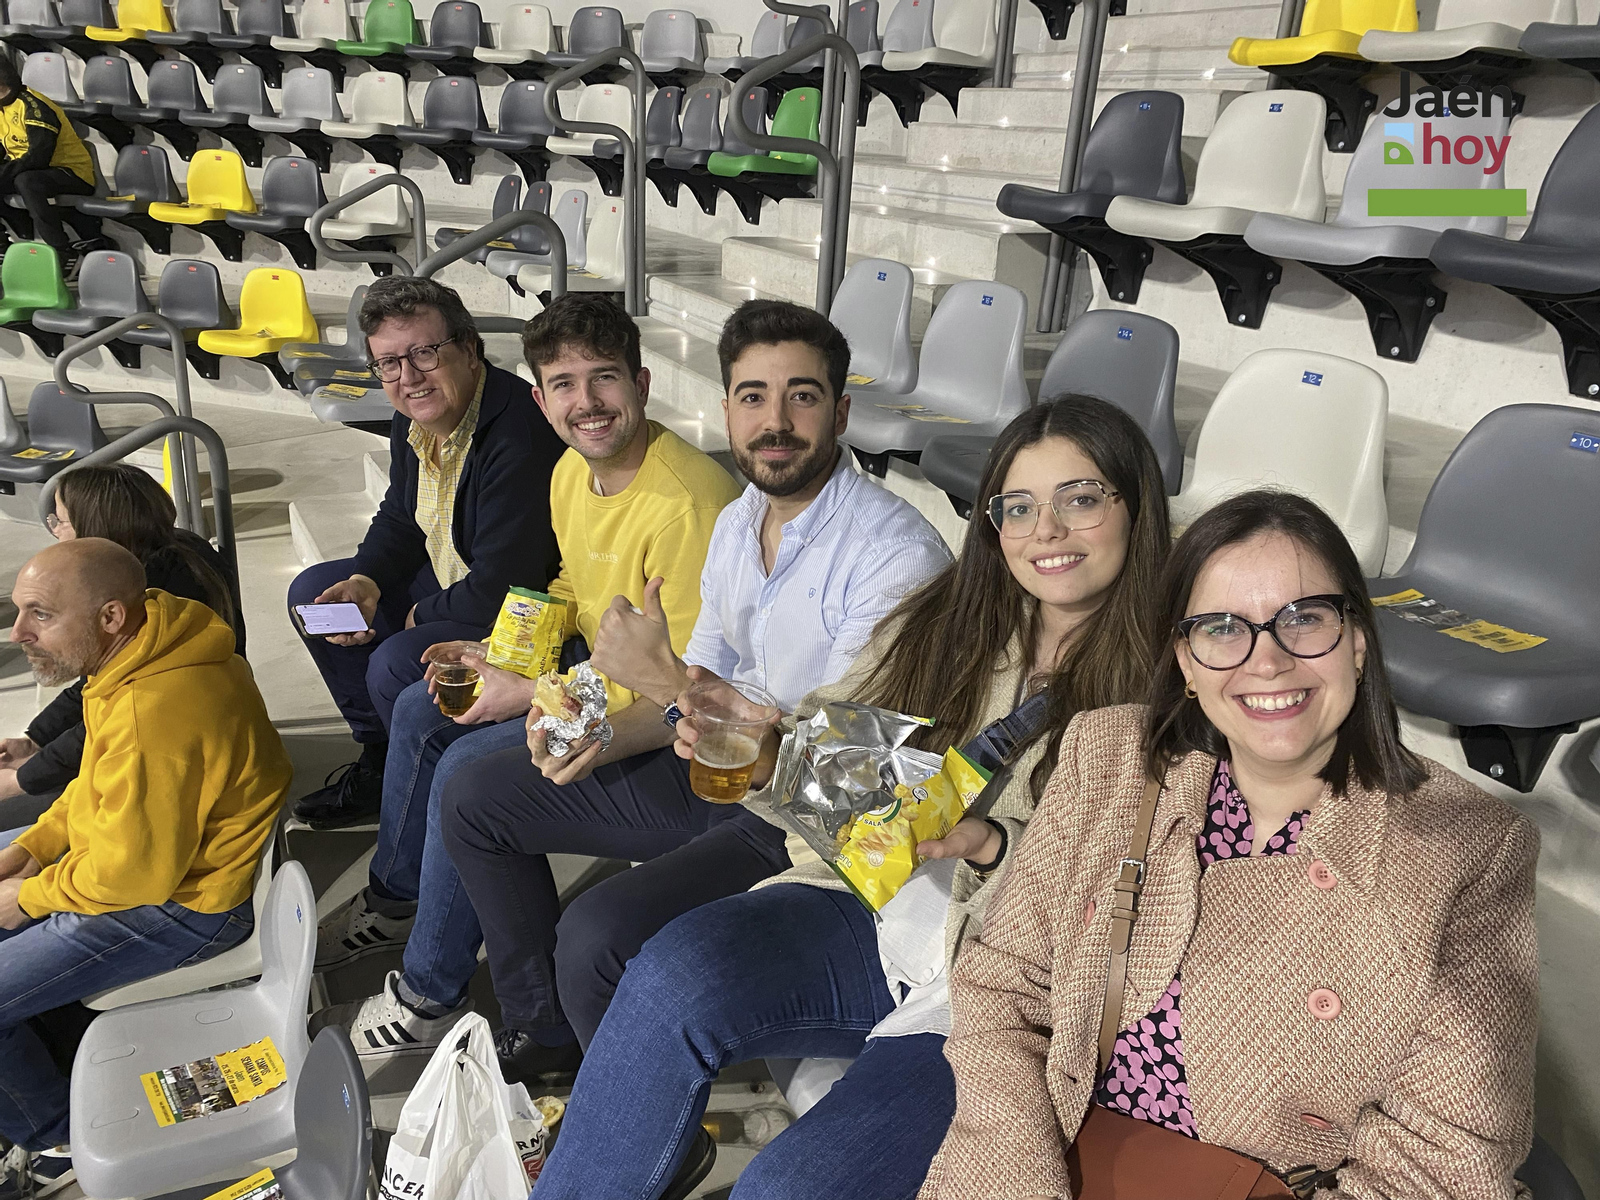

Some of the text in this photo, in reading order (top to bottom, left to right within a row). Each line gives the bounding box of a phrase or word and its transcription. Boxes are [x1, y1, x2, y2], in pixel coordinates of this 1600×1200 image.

[1309, 374, 1317, 384] 12
[1579, 437, 1592, 449] 10
[863, 818, 883, 827] SALA
[837, 854, 853, 869] ena
[240, 1055, 263, 1087] SEMANA SANTA
[255, 1057, 271, 1076] CAMPUS
